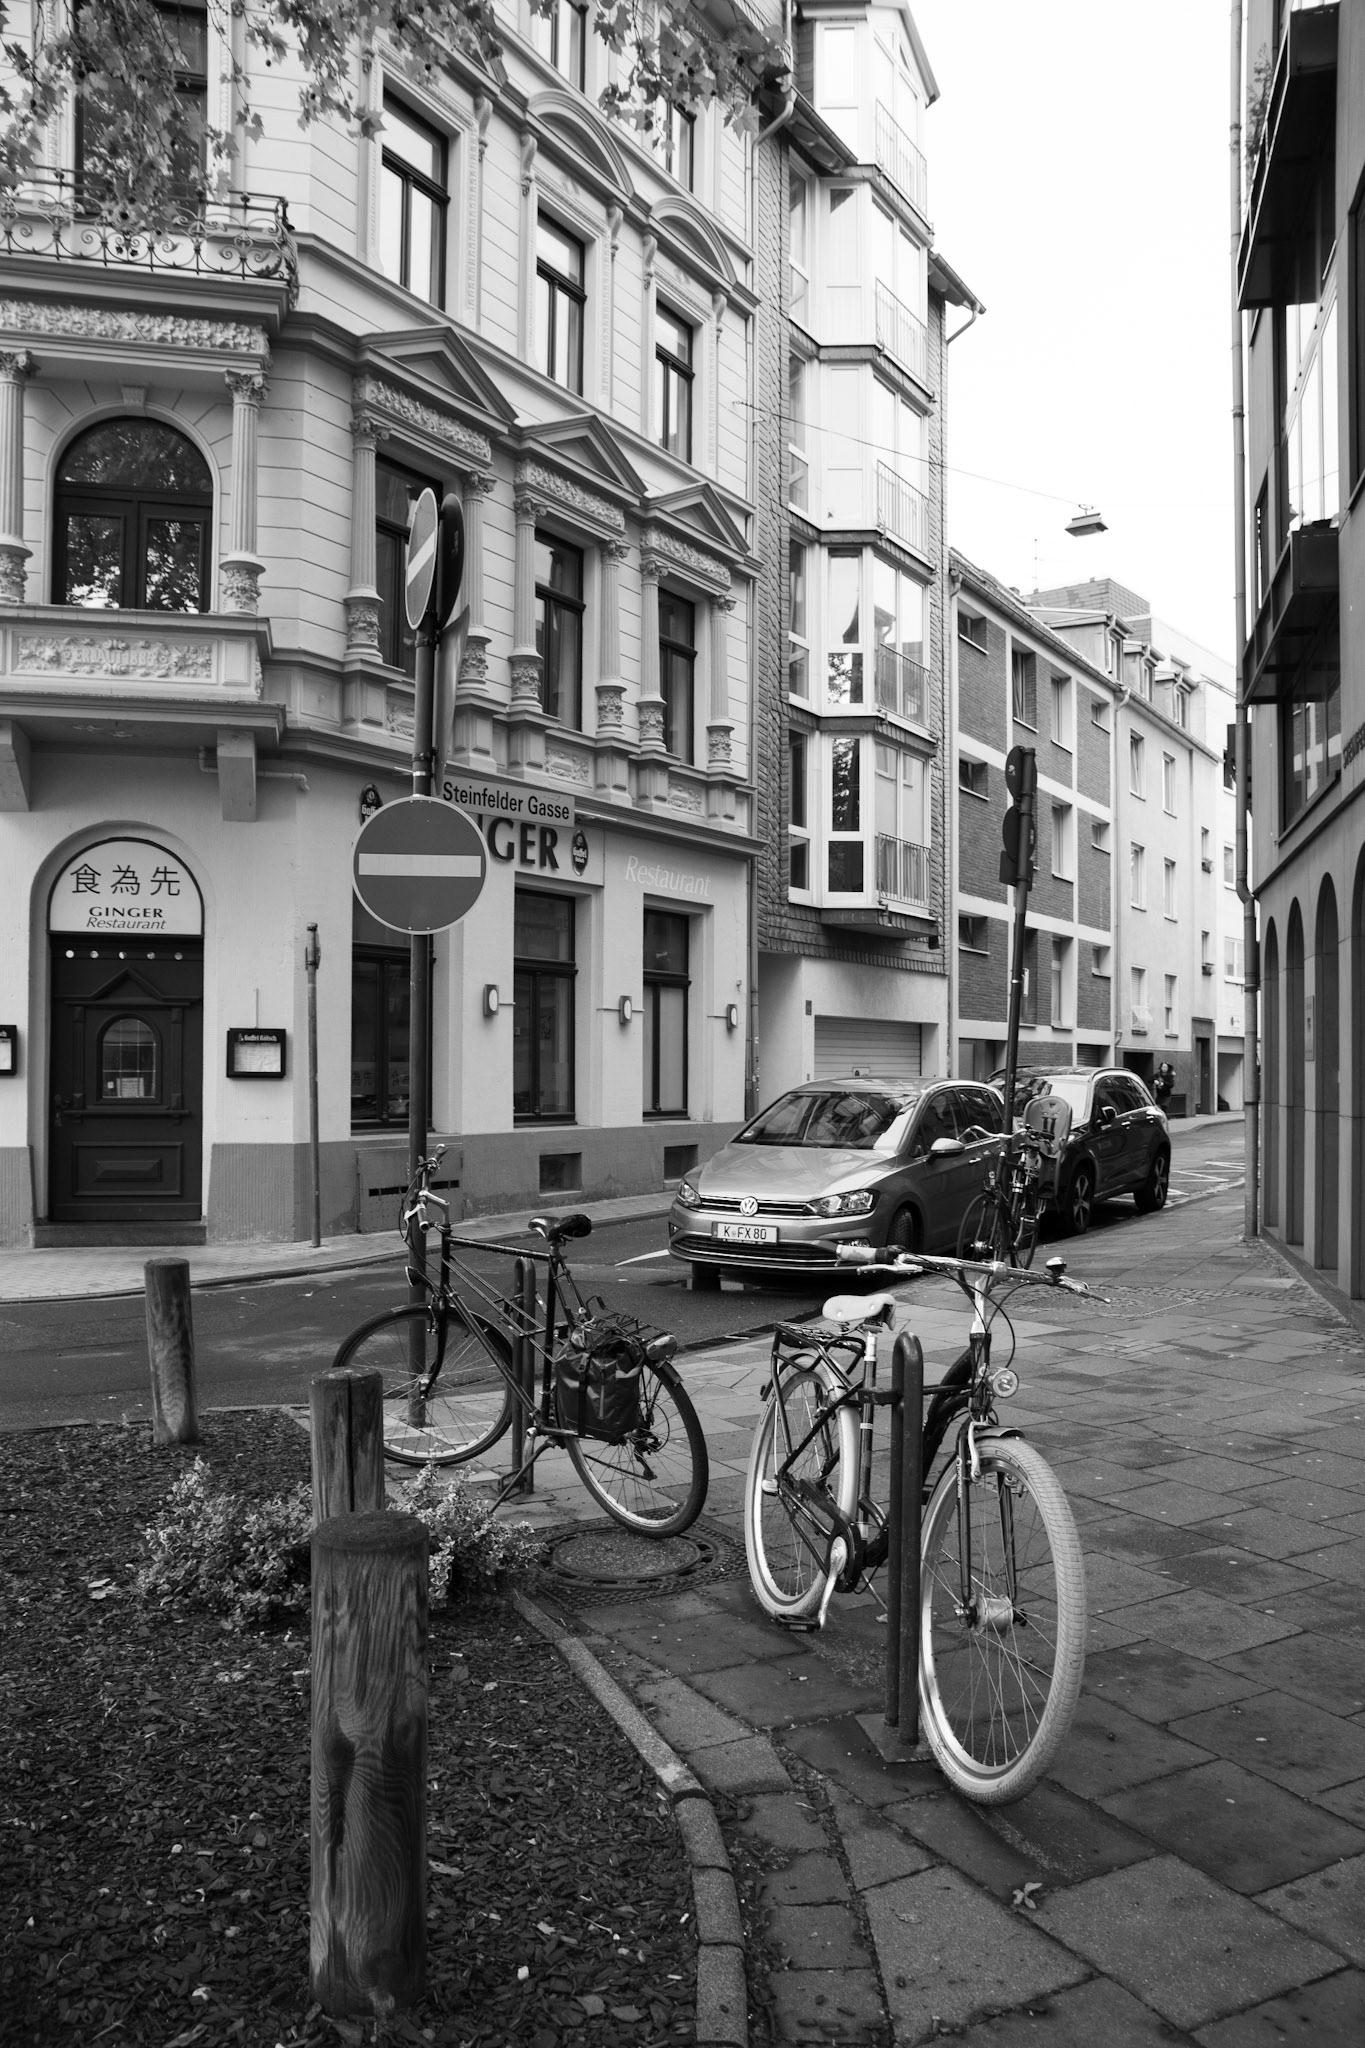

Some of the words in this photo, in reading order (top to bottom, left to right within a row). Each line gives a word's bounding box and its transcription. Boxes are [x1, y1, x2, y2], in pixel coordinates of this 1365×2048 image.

[443, 782, 523, 812] Steinfelder
[528, 796, 570, 820] Gasse
[70, 863, 180, 896] 食為先
[625, 855, 711, 896] Restaurant
[86, 916, 166, 929] Restaurant
[89, 906, 163, 918] GINGER
[724, 1226, 730, 1237] K
